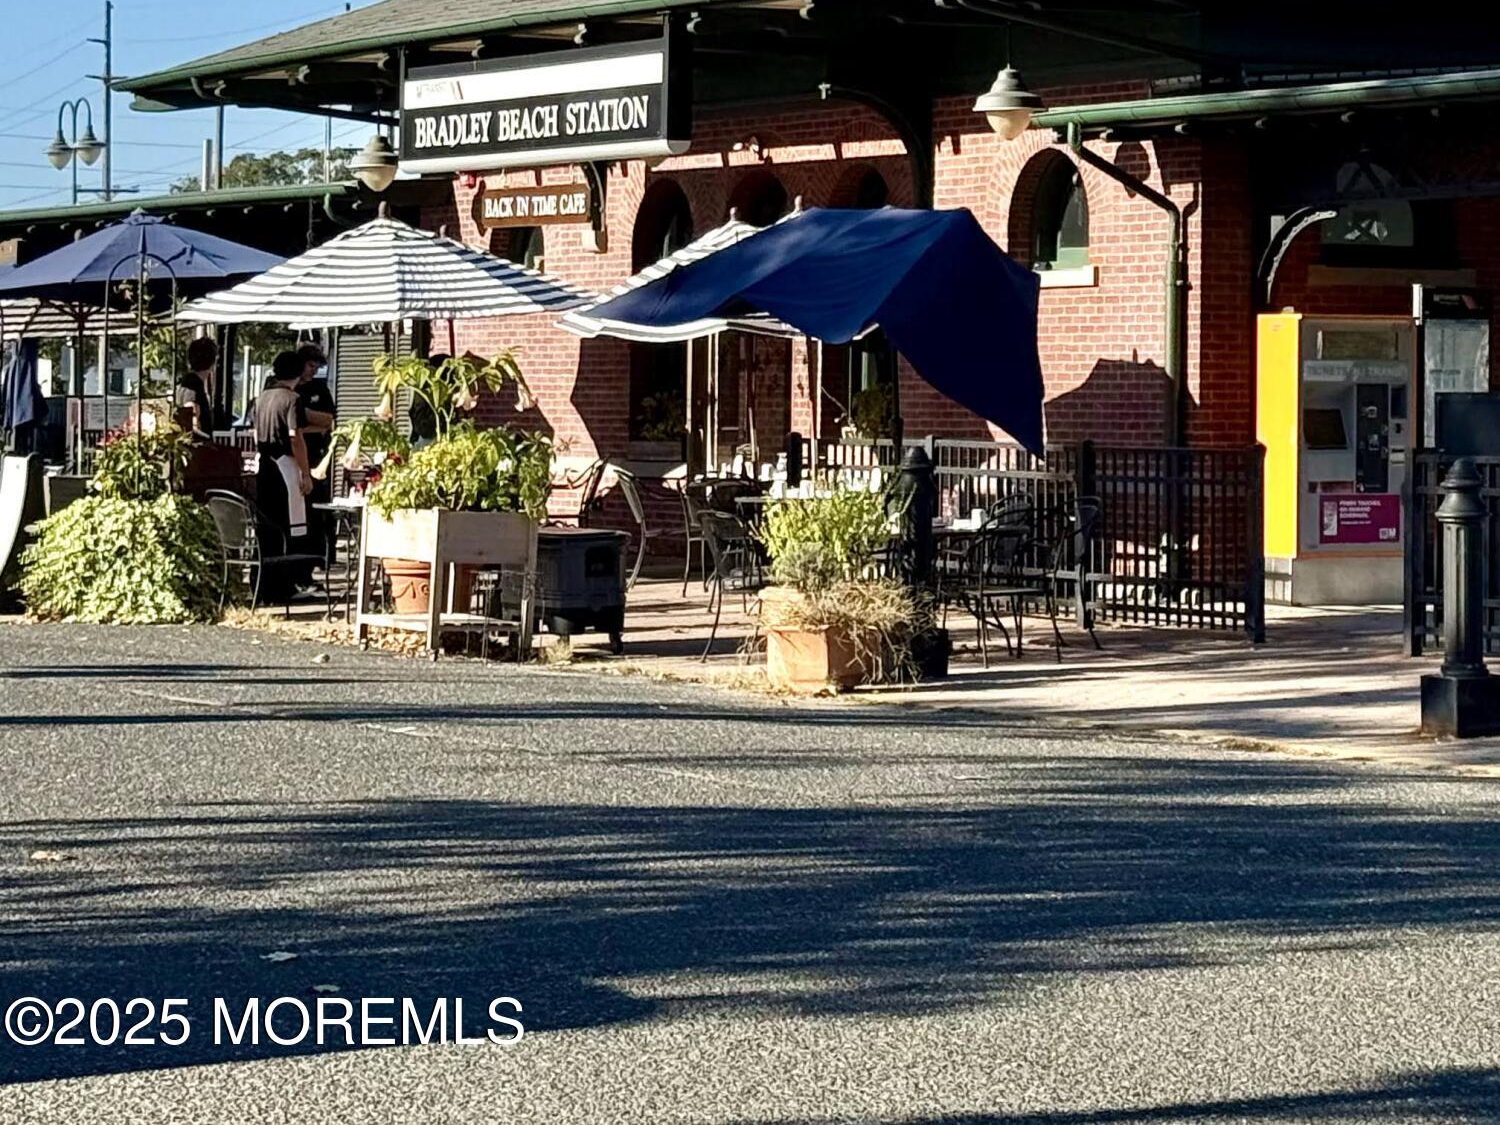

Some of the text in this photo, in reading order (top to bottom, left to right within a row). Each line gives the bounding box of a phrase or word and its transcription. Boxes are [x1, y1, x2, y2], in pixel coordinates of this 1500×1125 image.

[415, 96, 648, 148] BRADLEY BEACH STATION
[485, 193, 586, 218] BACK IN TIME CAFE
